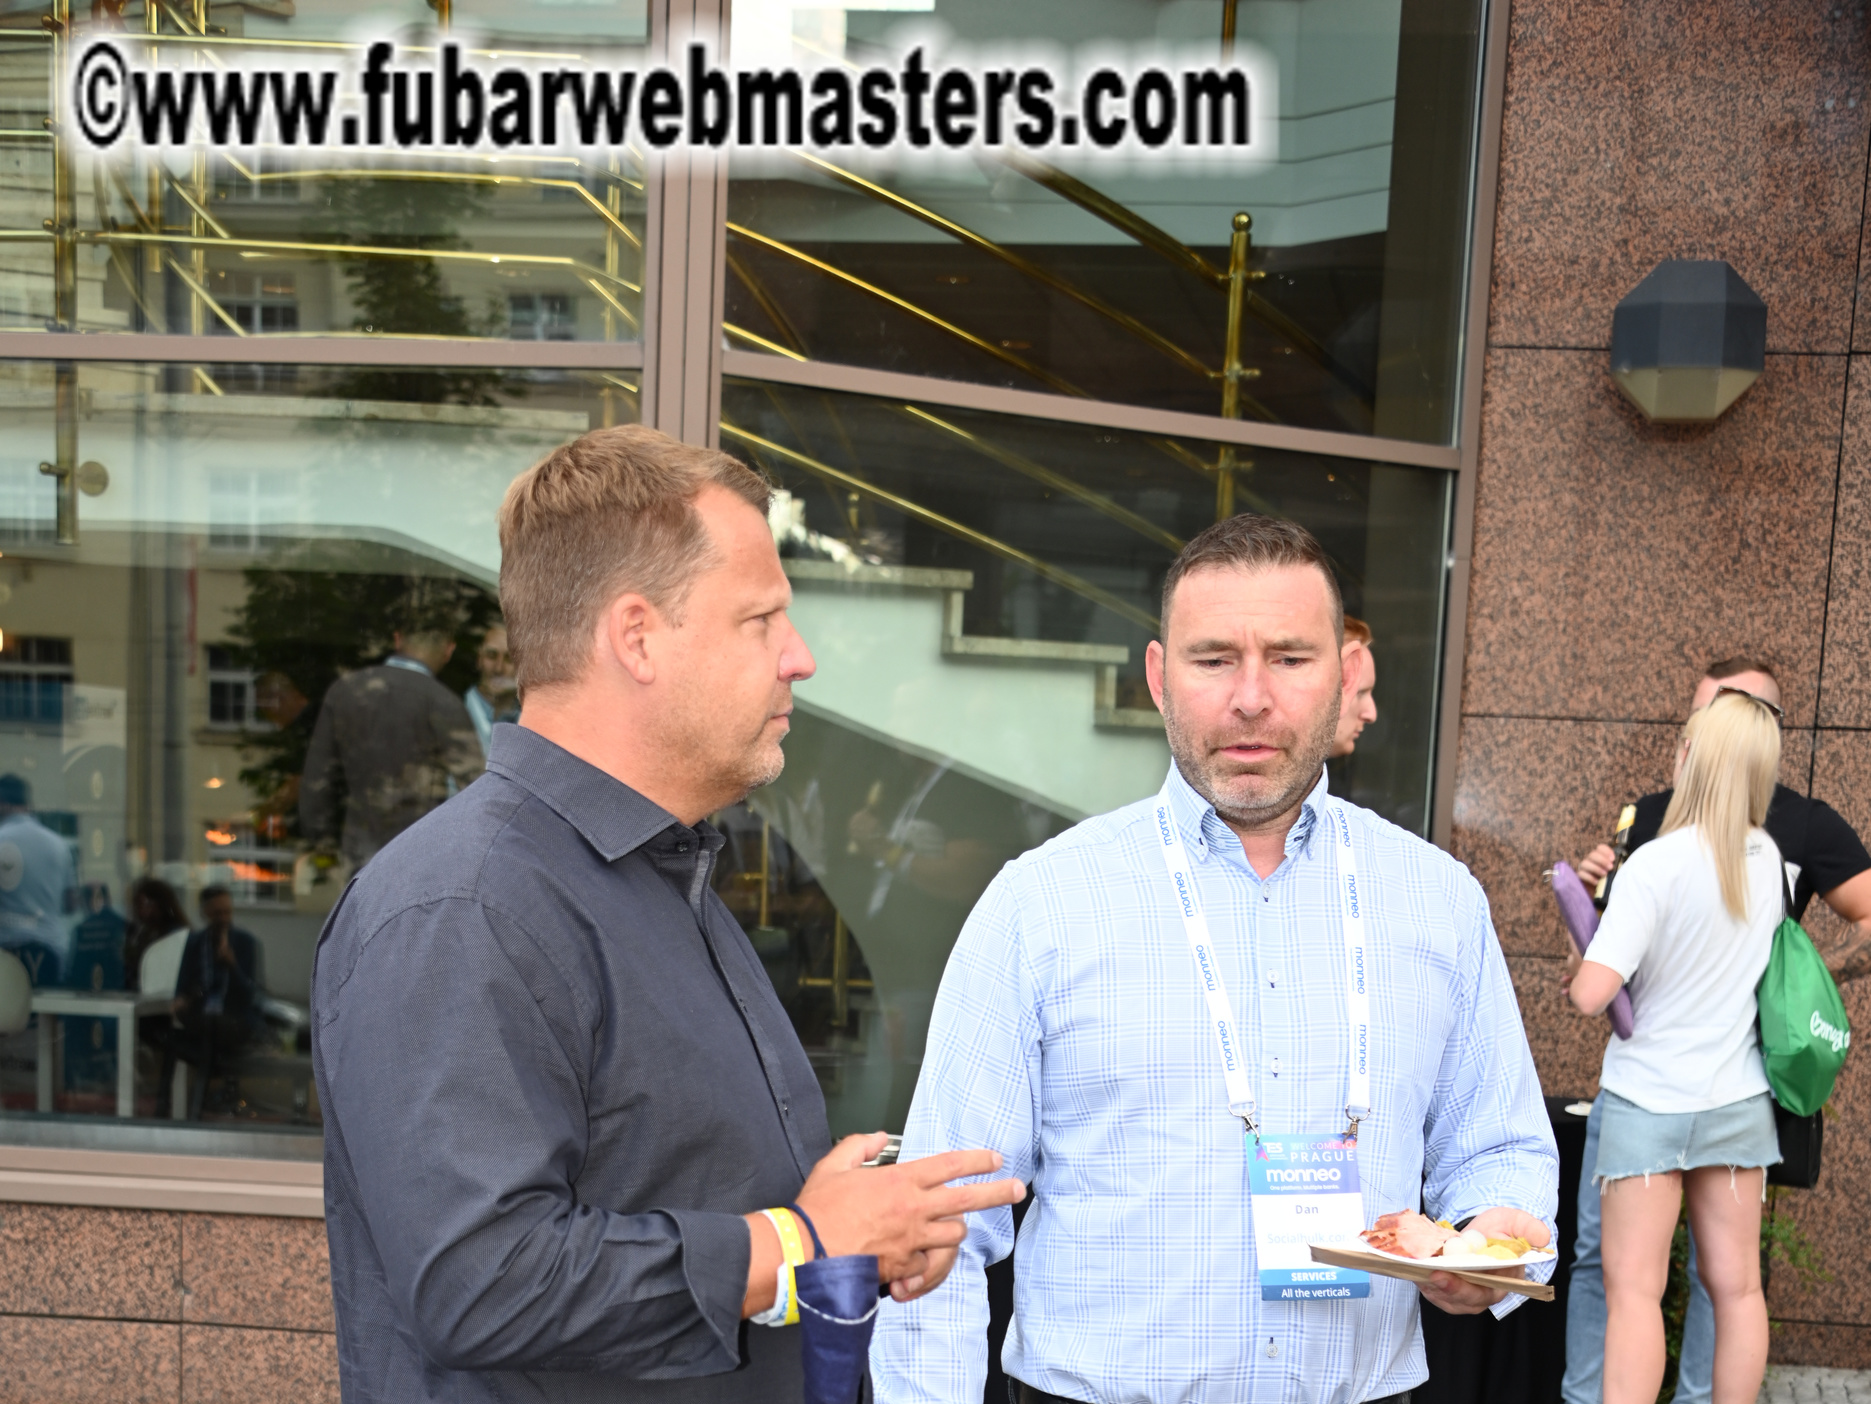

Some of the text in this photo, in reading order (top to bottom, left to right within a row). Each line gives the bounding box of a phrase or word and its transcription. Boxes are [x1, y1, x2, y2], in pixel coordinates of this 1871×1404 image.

[1156, 806, 1173, 846] monneo
[1335, 807, 1351, 848] monneo
[1174, 871, 1194, 918] monneo
[1347, 874, 1360, 919] monneo
[1195, 944, 1216, 991] monneo
[1354, 946, 1366, 995] monneo
[1217, 1020, 1236, 1072] monneo
[1359, 1024, 1367, 1075] monneo
[1290, 1141, 1337, 1151] WELCOME
[1290, 1150, 1355, 1163] PRAGUE
[1267, 1168, 1341, 1182] monneo
[1295, 1204, 1319, 1215] Dan
[1281, 1286, 1351, 1299] All the verticals
[1291, 1271, 1337, 1282] SERVICES
